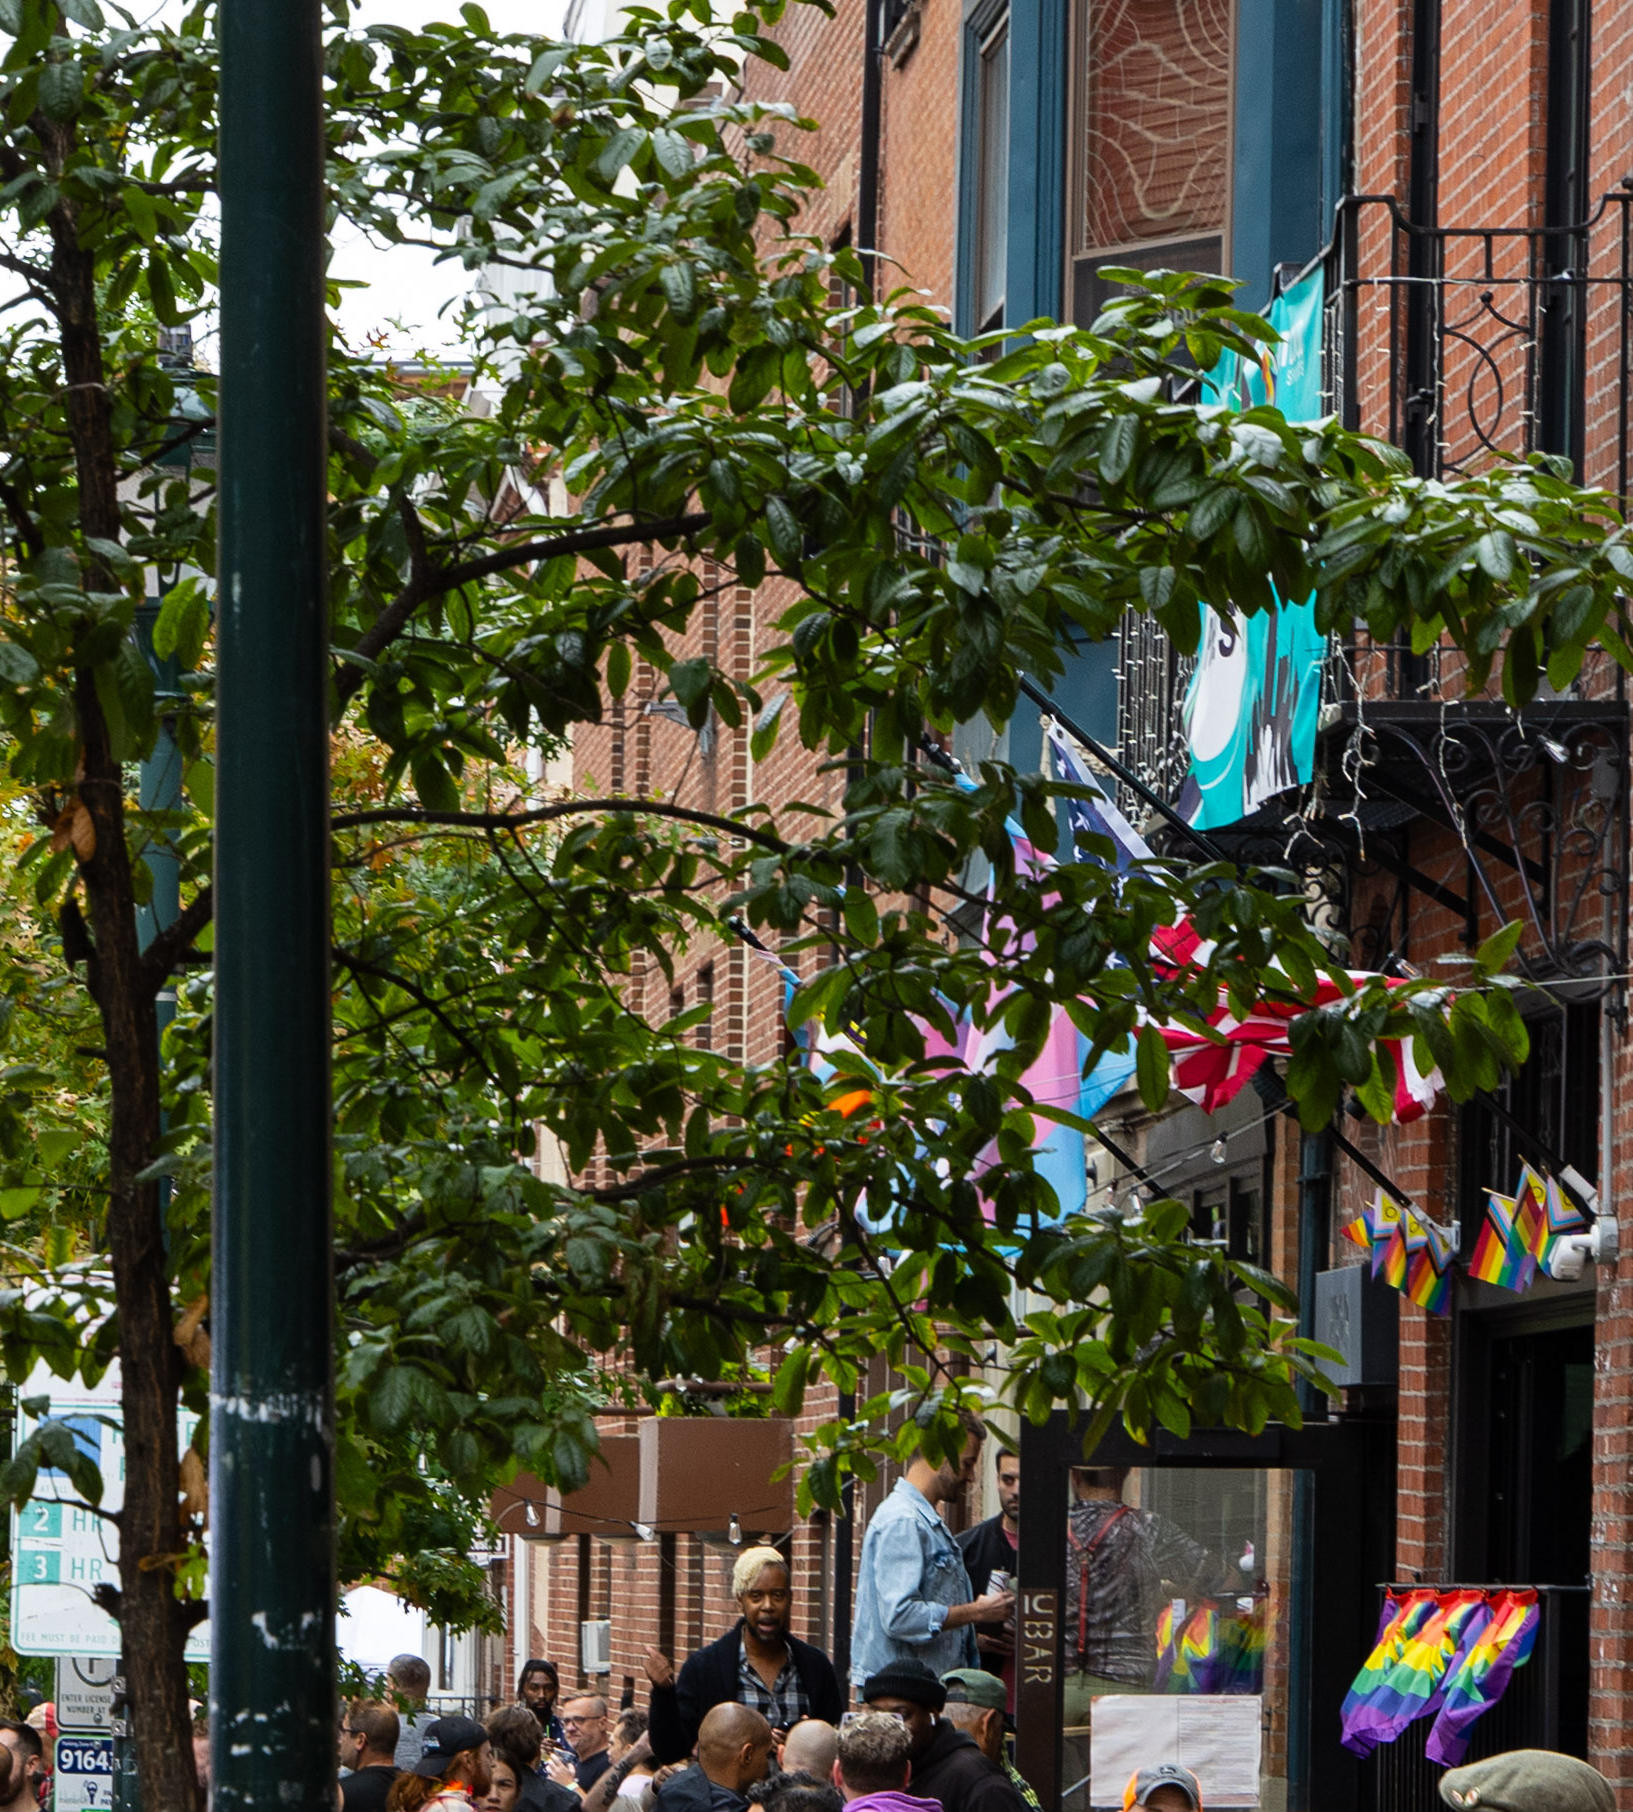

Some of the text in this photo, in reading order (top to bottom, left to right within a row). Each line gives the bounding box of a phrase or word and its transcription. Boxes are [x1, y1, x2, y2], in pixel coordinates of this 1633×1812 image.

[33, 1507, 104, 1533] 2 HR
[33, 1555, 103, 1580] 3 HR
[21, 1632, 37, 1641] FEE
[41, 1633, 65, 1643] MUST
[69, 1634, 81, 1643] BE
[85, 1635, 108, 1645] PAID
[61, 1694, 111, 1704] ENTER LICENSE
[66, 1705, 94, 1714] NUMBER
